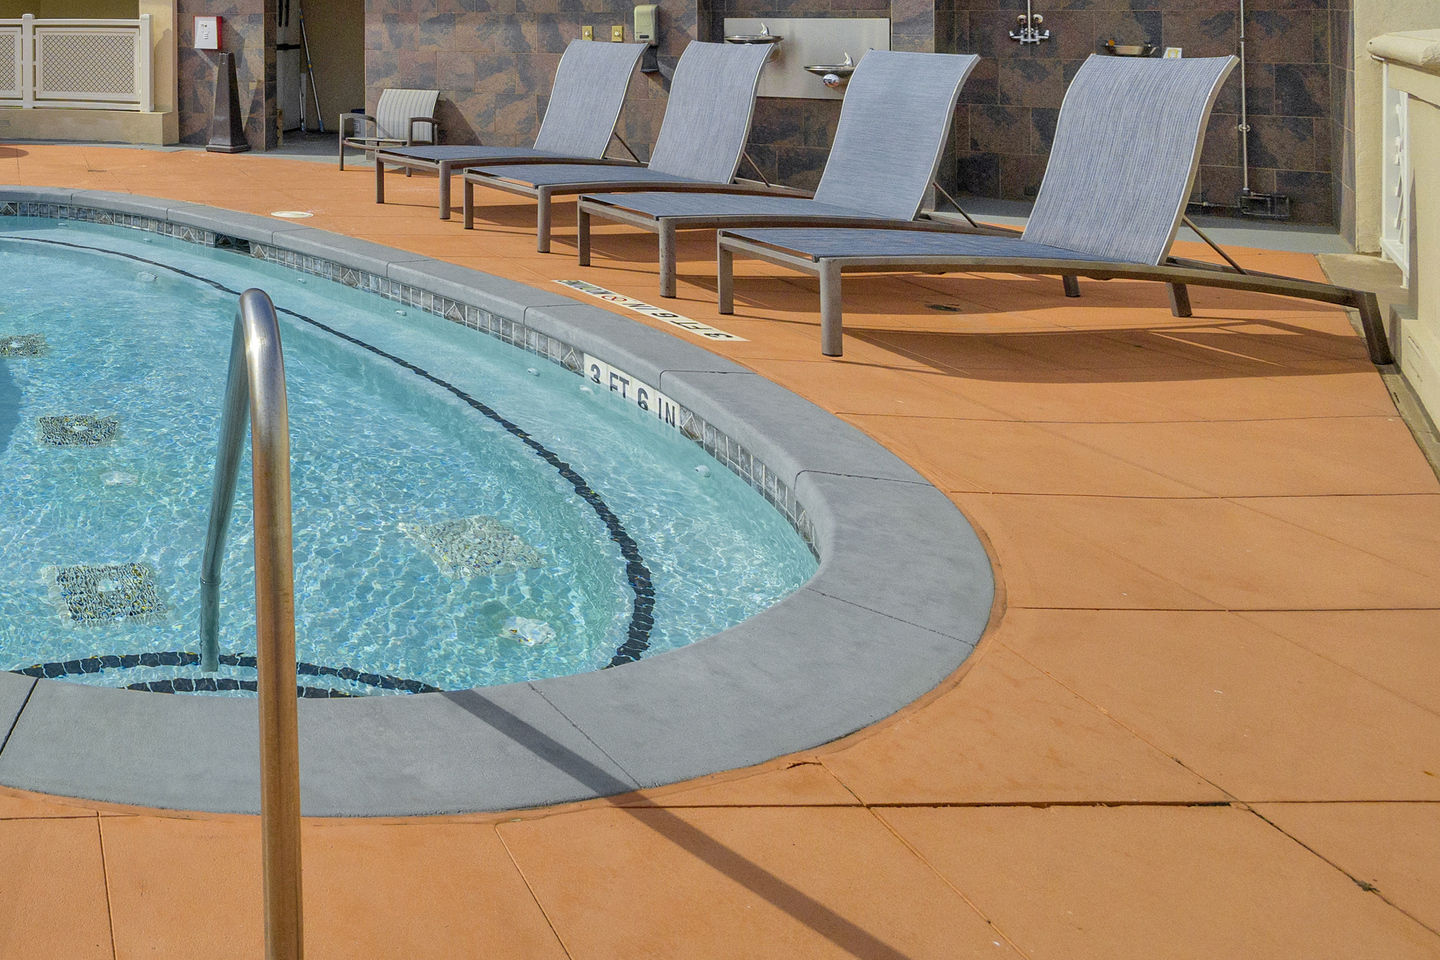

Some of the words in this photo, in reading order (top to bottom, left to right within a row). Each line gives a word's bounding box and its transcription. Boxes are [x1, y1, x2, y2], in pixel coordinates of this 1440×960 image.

[590, 363, 601, 385] 3
[609, 371, 630, 399] FT
[637, 387, 649, 411] 6
[658, 397, 676, 429] IN
